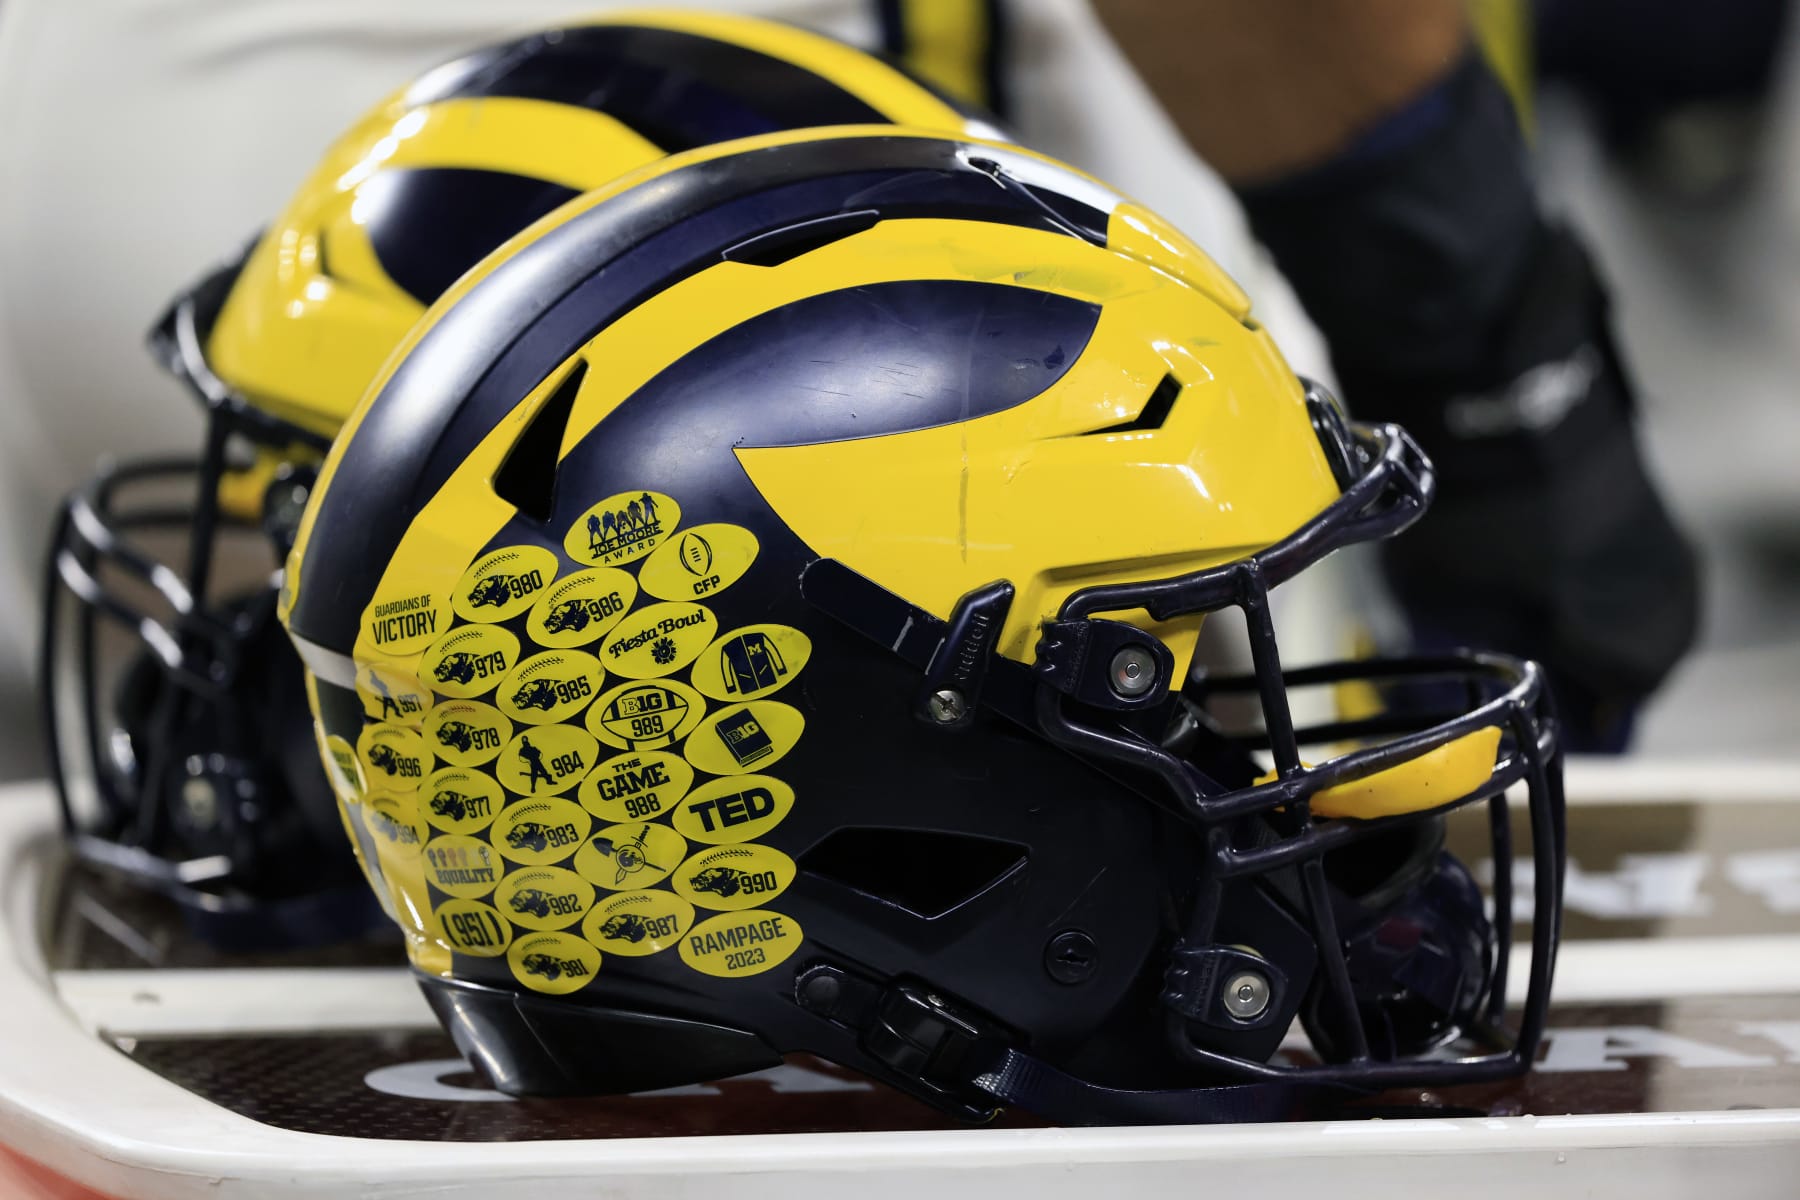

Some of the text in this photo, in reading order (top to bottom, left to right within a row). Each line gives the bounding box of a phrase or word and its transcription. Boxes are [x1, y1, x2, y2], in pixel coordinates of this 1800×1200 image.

[593, 523, 662, 557] JOE MOORE
[603, 537, 656, 565] AWARD
[510, 569, 544, 600] 980
[692, 574, 721, 595] CFP
[375, 594, 432, 618] GUARDIANS OF
[587, 591, 624, 623] 986
[372, 608, 437, 645] VICTORY
[608, 608, 707, 659] Fiesta Bowl
[748, 642, 763, 656] M
[474, 650, 507, 679] 979
[555, 674, 592, 705] 985
[471, 727, 501, 751] 978
[631, 714, 664, 738] 989
[397, 757, 422, 778] 996
[551, 750, 585, 778] 984
[611, 758, 642, 773] THE
[597, 761, 671, 801] GAME
[465, 795, 492, 819] 977
[624, 792, 661, 819] 988
[688, 787, 775, 832] TED
[545, 822, 580, 849] 983
[435, 868, 496, 887] EQUALITY
[740, 870, 778, 896] 990
[550, 893, 583, 916] 982
[645, 914, 680, 940] 987
[689, 917, 787, 957] RAMPAGE
[559, 958, 590, 979] 981
[724, 948, 767, 971] 2023
